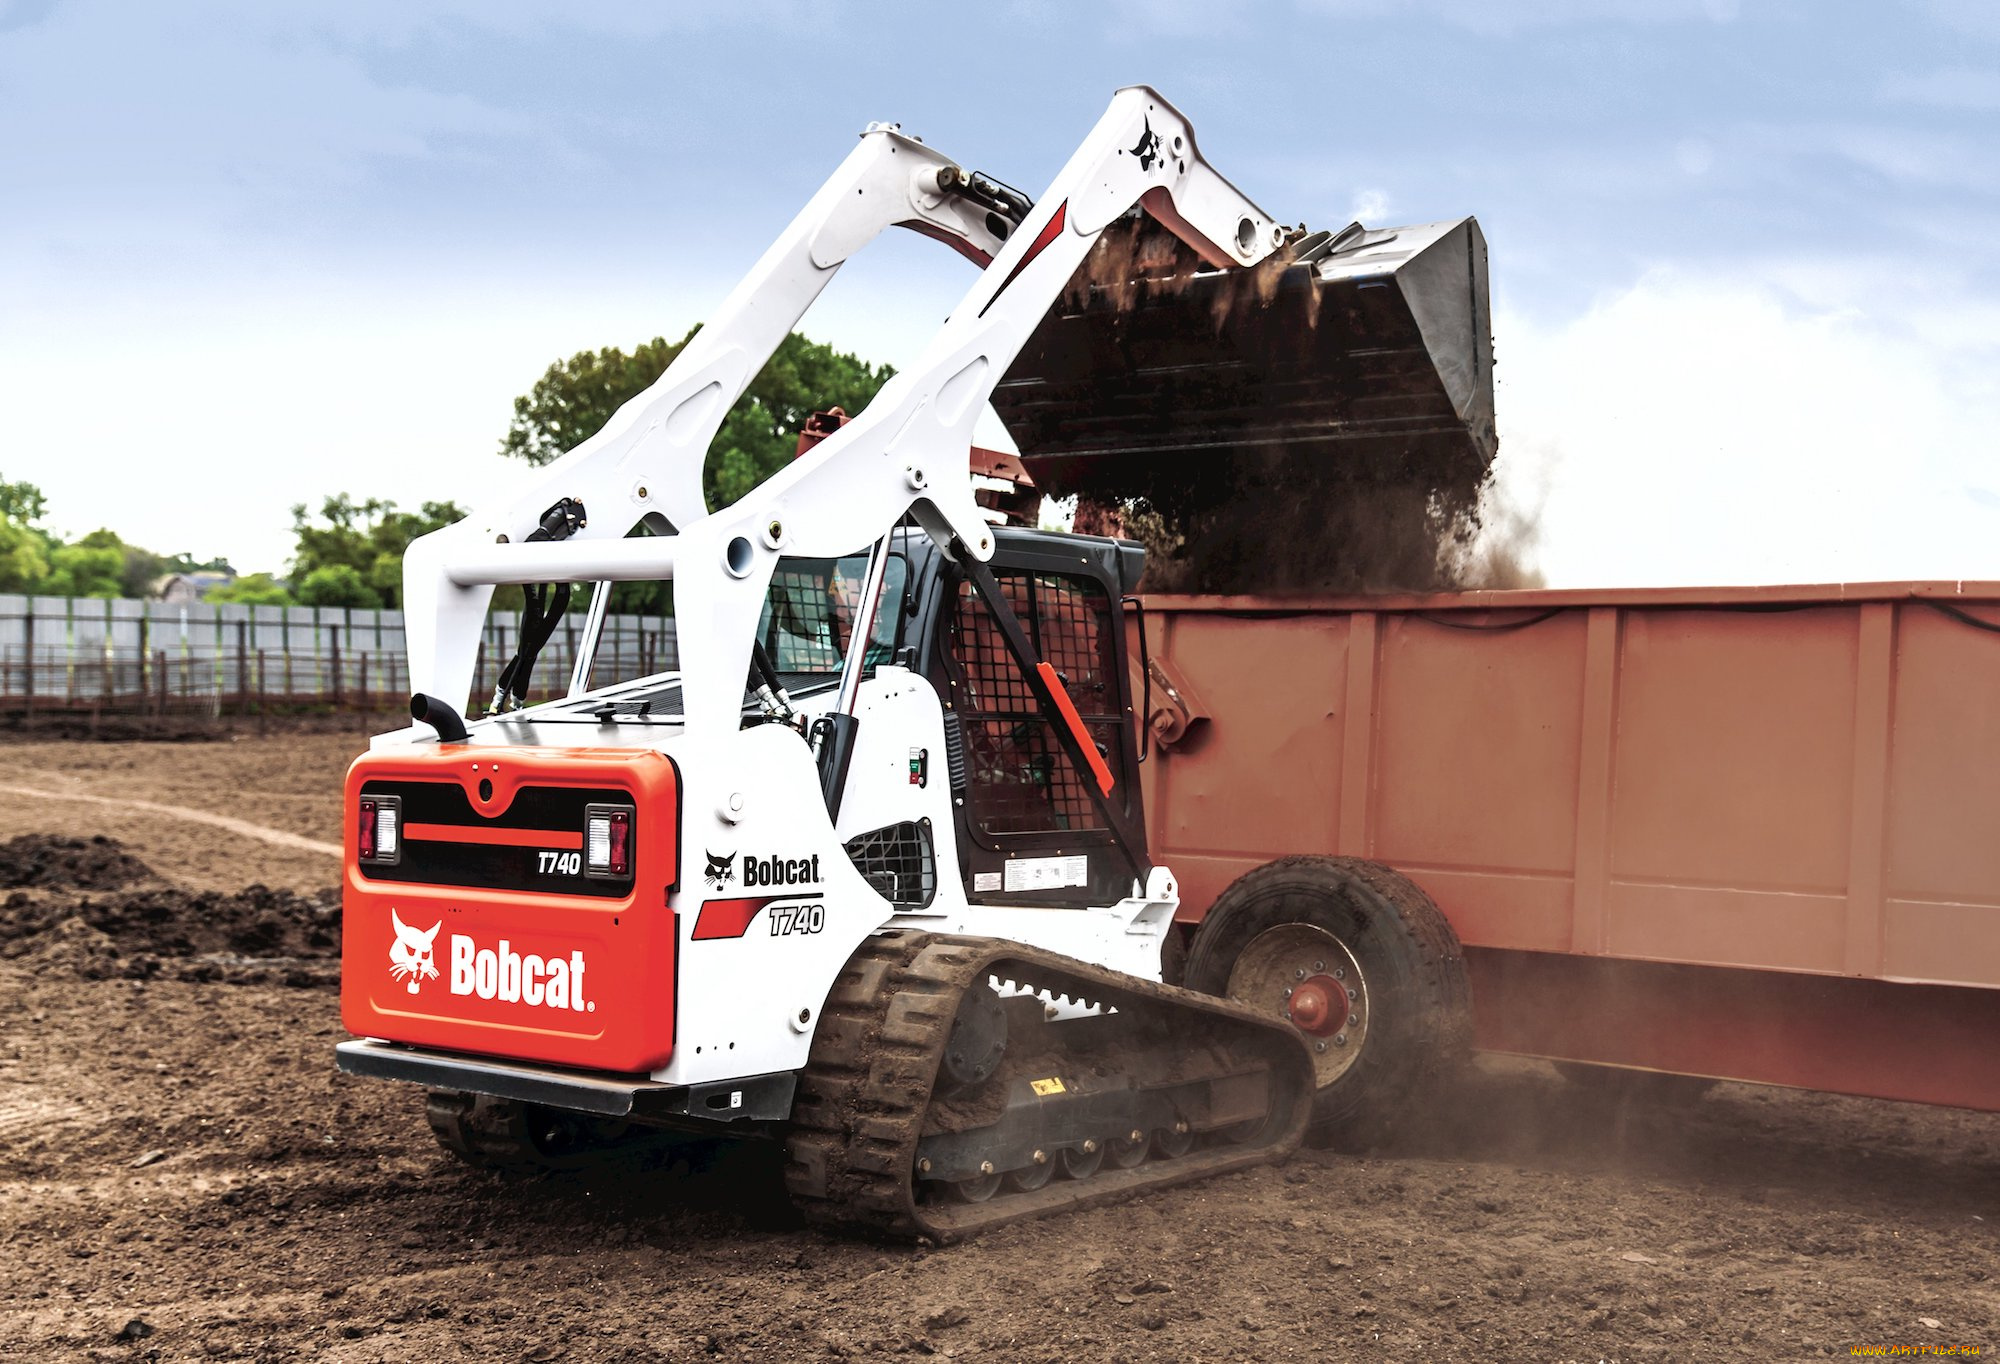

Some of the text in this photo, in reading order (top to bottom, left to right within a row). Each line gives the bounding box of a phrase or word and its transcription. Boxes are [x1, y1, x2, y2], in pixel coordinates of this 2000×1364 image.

[538, 851, 581, 875] T740
[743, 854, 819, 887] Bobcat
[769, 904, 825, 937] T740
[450, 933, 586, 1012] Bobcat
